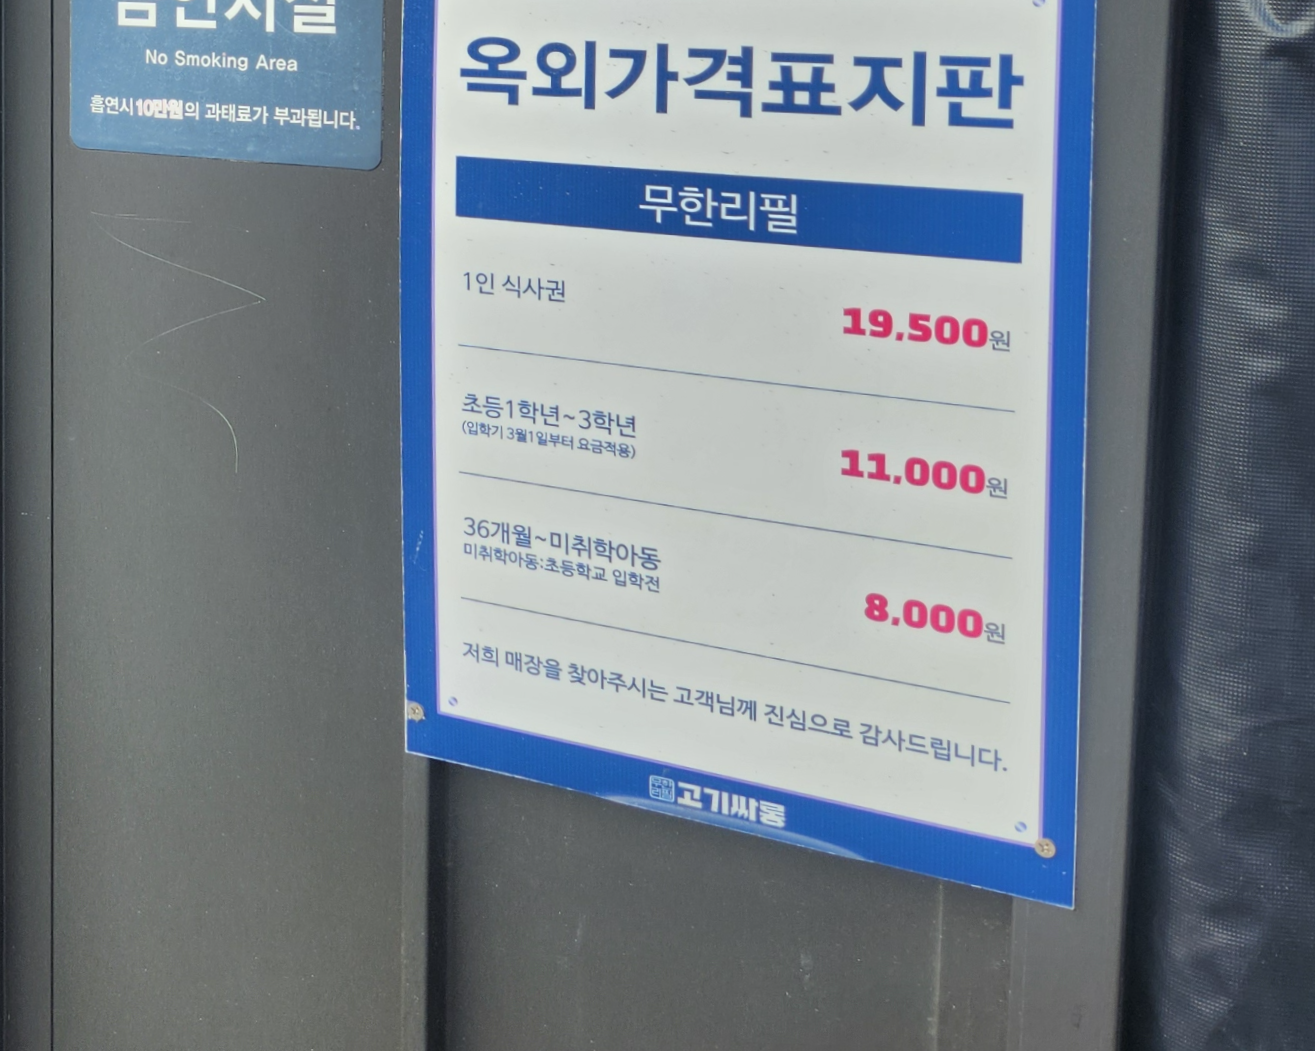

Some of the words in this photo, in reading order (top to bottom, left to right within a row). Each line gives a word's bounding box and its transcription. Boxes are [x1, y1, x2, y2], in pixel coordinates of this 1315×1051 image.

[145, 49, 168, 64] No
[175, 50, 248, 70] Smoking
[256, 54, 298, 71] Area
[459, 36, 1024, 129] 옥외가격표지판
[204, 103, 268, 124] 과태료가
[273, 106, 361, 130] 부과됩니다.
[638, 183, 799, 235] 무한리필
[463, 271, 495, 295] 1인
[501, 274, 565, 303] 식사권
[461, 393, 637, 439] 초등1학년~3학년
[463, 516, 662, 571] 36개월~미취학아동
[612, 568, 661, 593] 입학전
[462, 641, 499, 667] 저희
[505, 650, 562, 681] 매장을
[567, 663, 669, 702] 찾아주시는
[672, 685, 757, 722] 고객님께
[763, 703, 853, 739] 진심으로
[858, 722, 1008, 772] 감사드립니다.
[677, 781, 786, 828] 고기싸롱
